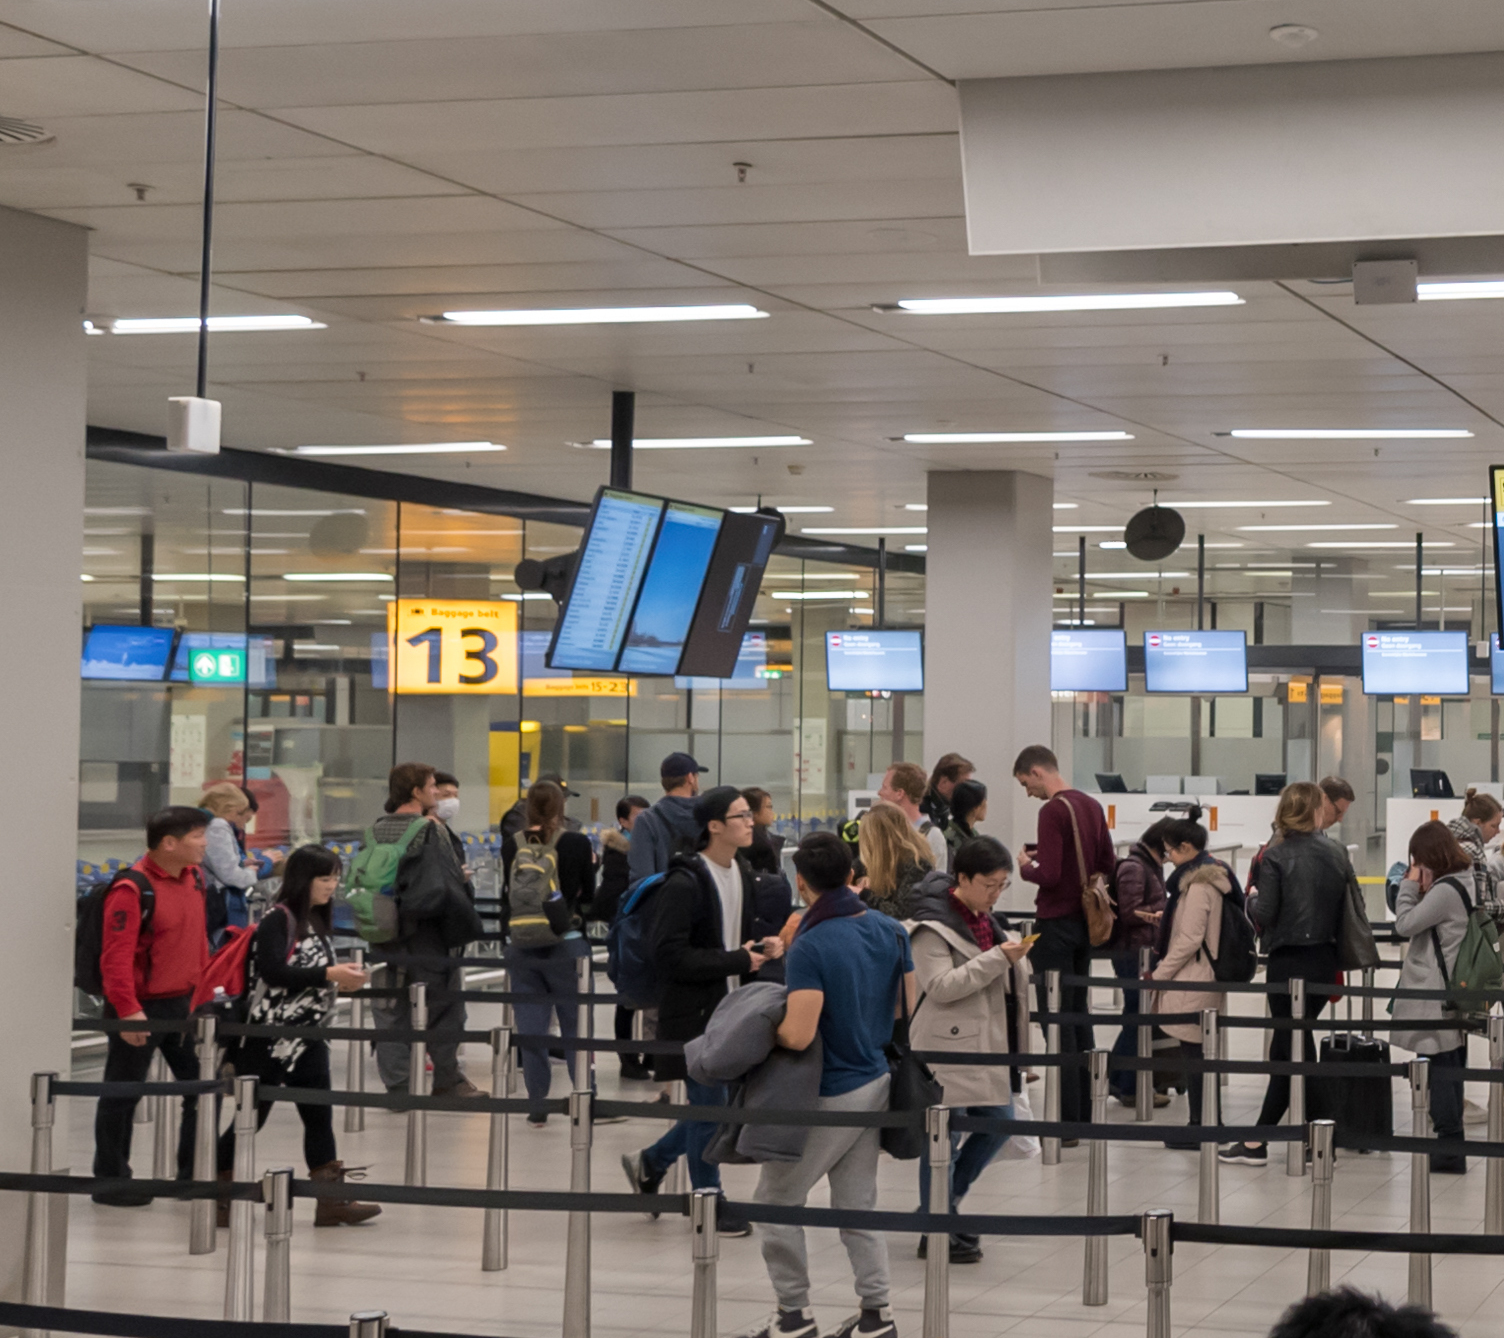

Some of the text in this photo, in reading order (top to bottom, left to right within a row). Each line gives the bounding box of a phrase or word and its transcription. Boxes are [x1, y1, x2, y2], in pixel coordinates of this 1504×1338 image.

[431, 607, 500, 619] Baggage belt
[406, 626, 499, 685] 13
